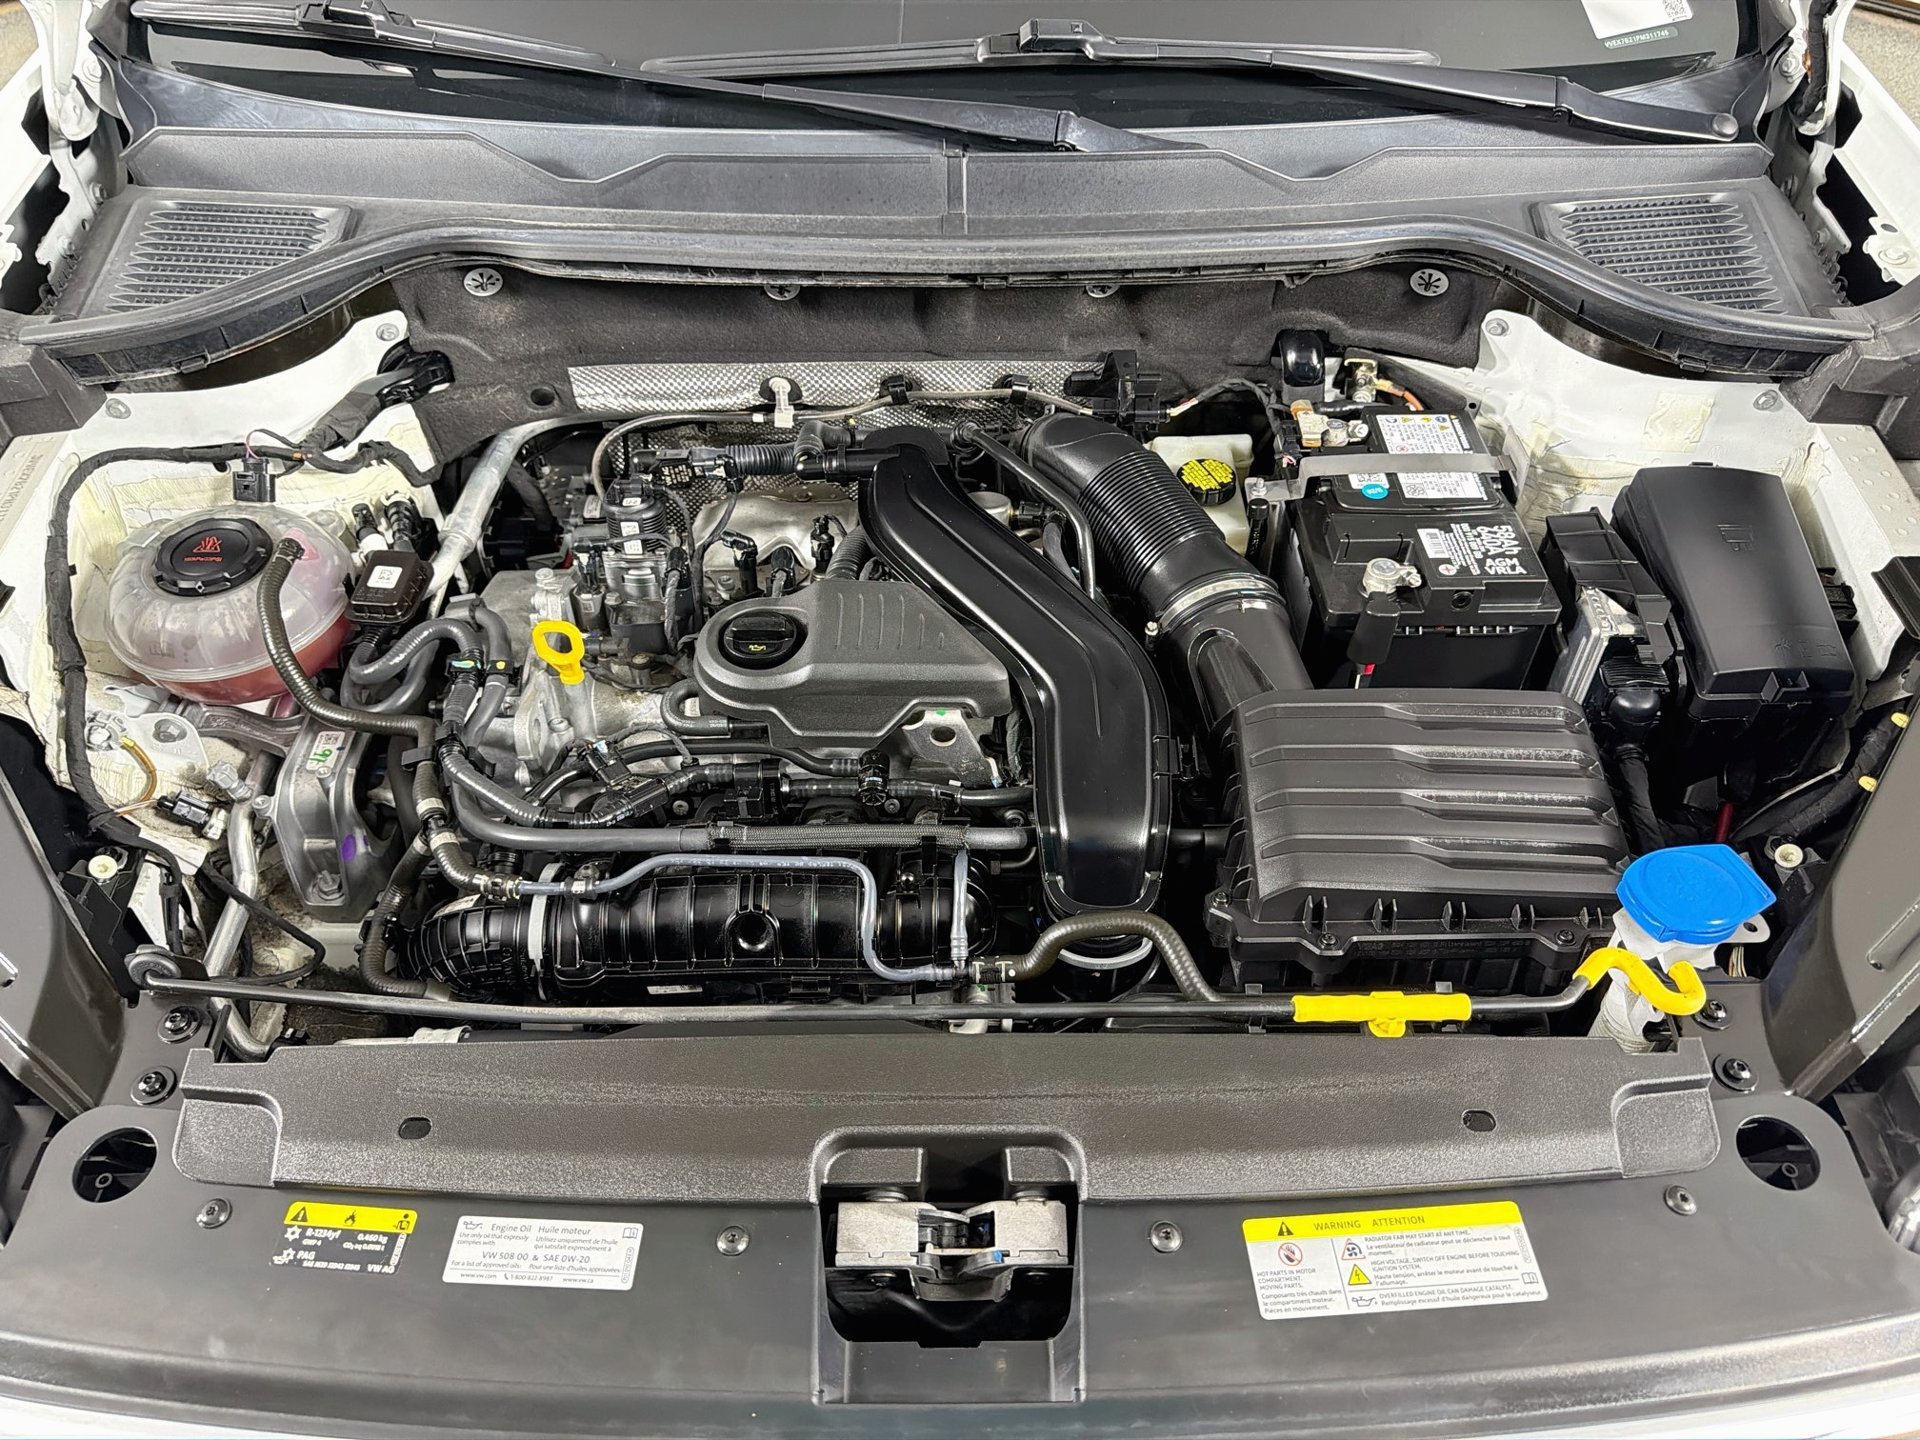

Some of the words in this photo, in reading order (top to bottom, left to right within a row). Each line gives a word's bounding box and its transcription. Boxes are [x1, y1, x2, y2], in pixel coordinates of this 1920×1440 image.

[1476, 526, 1506, 555] 640A
[1493, 525, 1522, 555] 58Ah
[1485, 558, 1520, 566] AGM
[1484, 565, 1527, 575] VRLA
[491, 1223, 518, 1233] Engine
[520, 1224, 531, 1232] Oil
[538, 1225, 559, 1234] Huile
[561, 1227, 591, 1235] moteur
[1314, 1219, 1361, 1231] WARNING
[1372, 1215, 1425, 1227] ATTENTION
[305, 1228, 342, 1241] R-1234yf
[379, 1234, 388, 1244] kg
[558, 1237, 592, 1245] uniquement
[296, 1250, 316, 1260] PAG
[367, 1263, 381, 1272] VW
[381, 1264, 395, 1274] AG
[482, 1251, 497, 1259] VW
[499, 1252, 515, 1260] 508
[517, 1253, 529, 1261] 00
[543, 1254, 559, 1263] SAE
[562, 1254, 590, 1263] 0W-20
[1258, 1276, 1303, 1284] COMPARTMENT.
[1379, 1291, 1414, 1299] OVERFILLED
[1415, 1289, 1436, 1297] ENGINE
[1381, 1298, 1417, 1306] Remplissage
[1441, 1294, 1460, 1302] d'huile
[1462, 1292, 1491, 1300] dangereux
